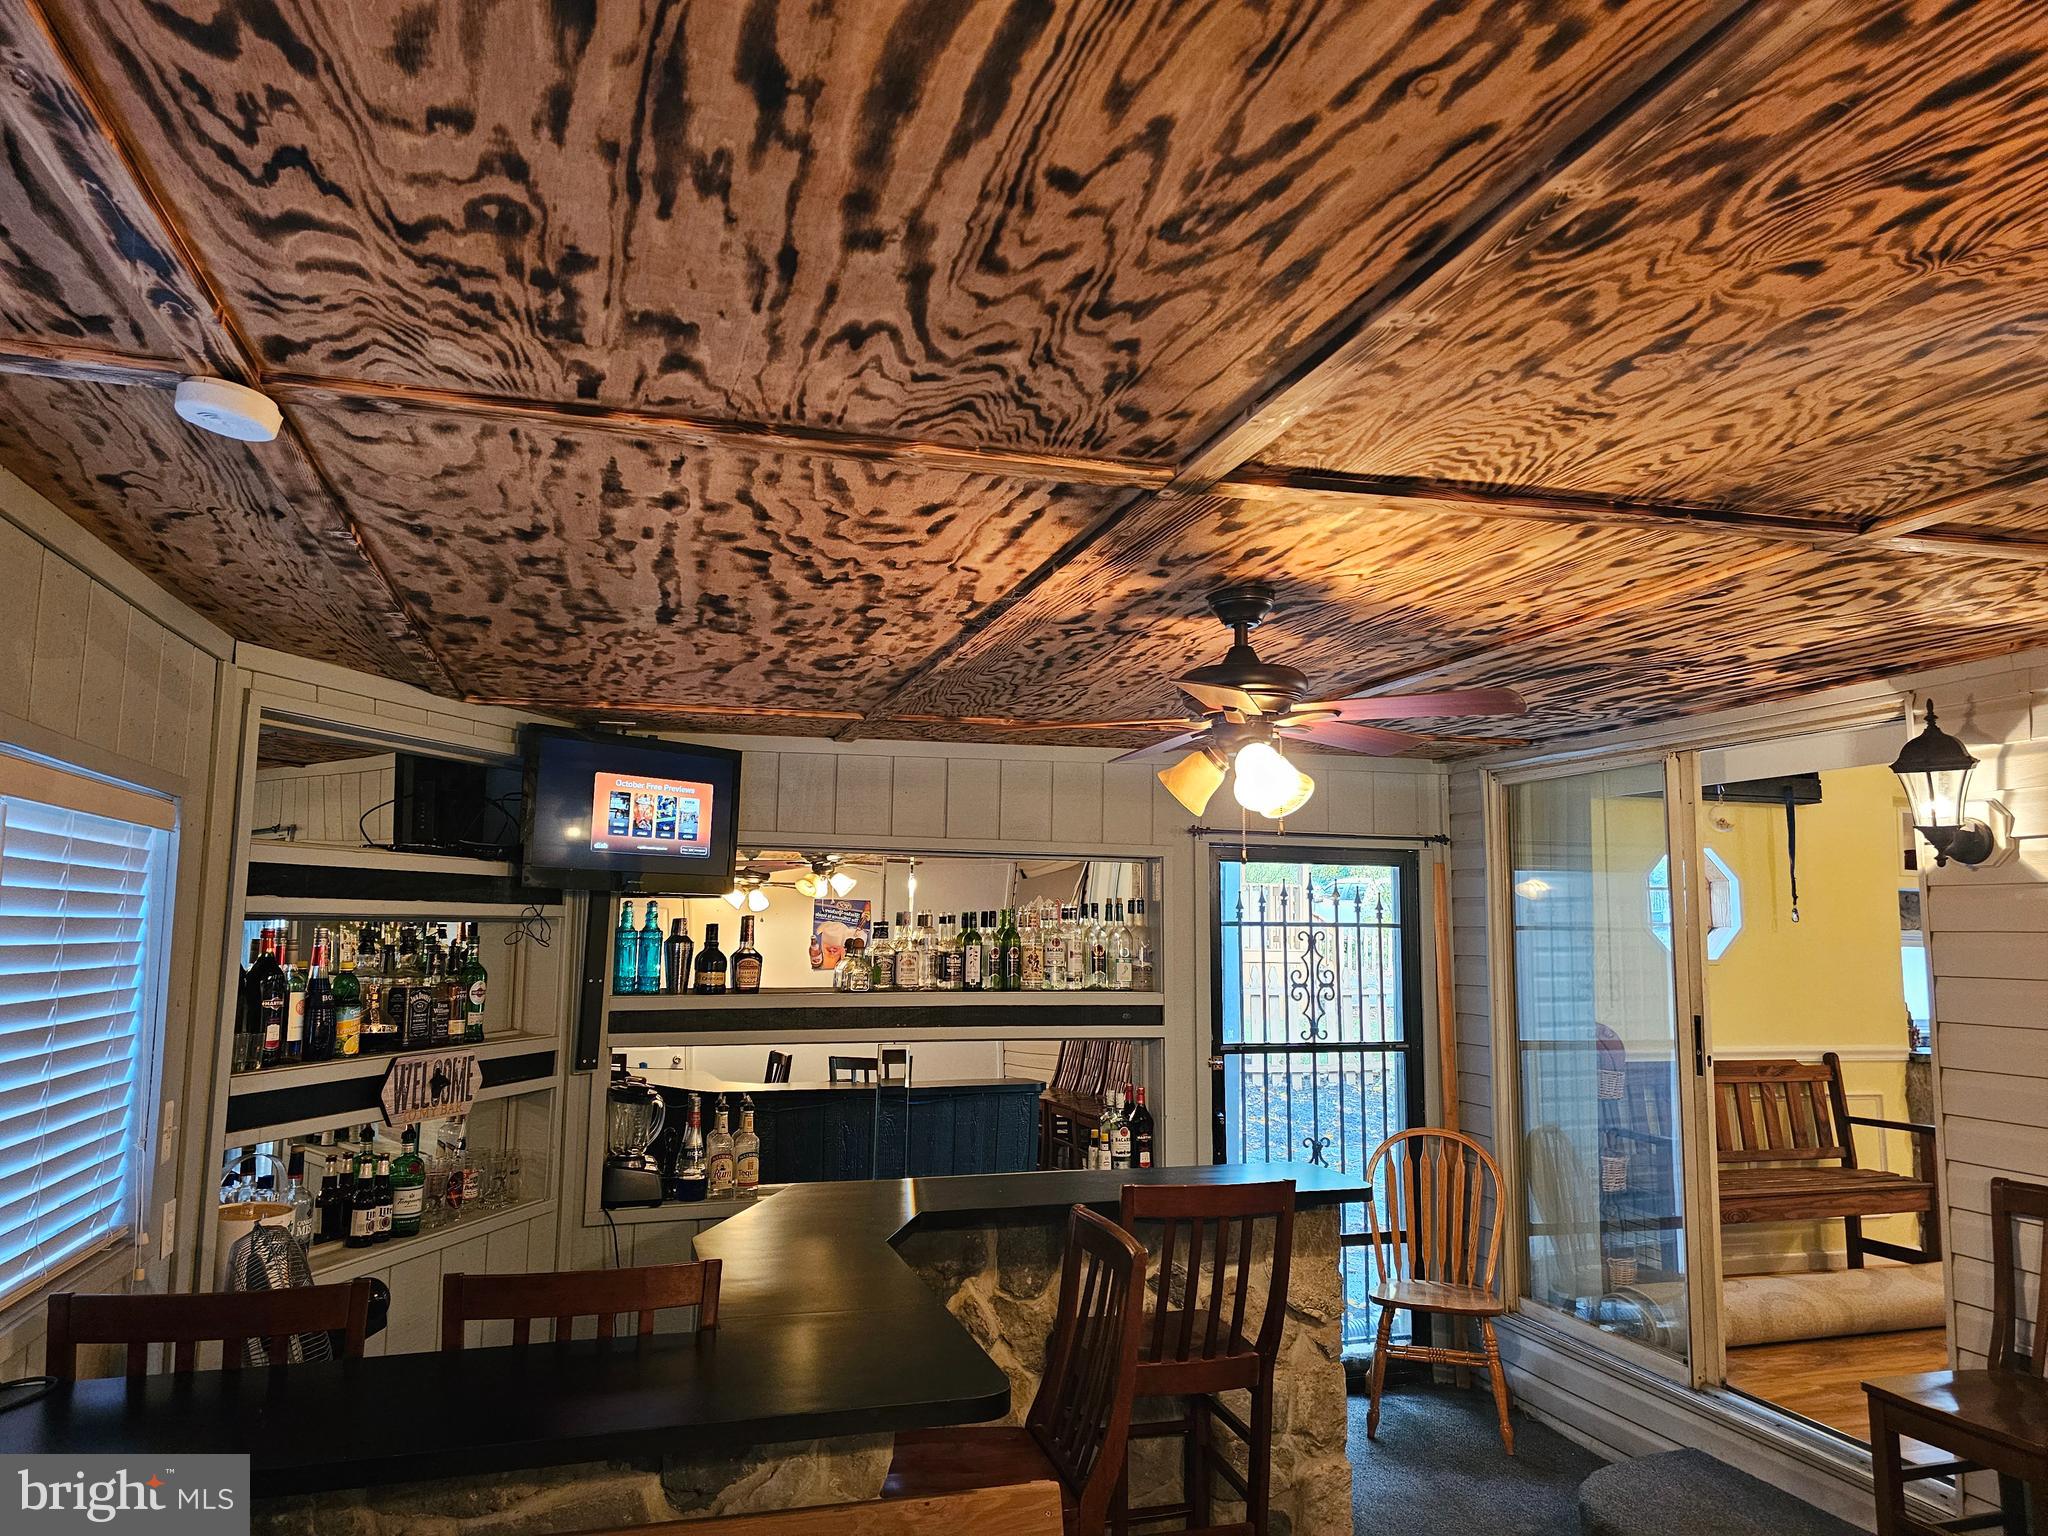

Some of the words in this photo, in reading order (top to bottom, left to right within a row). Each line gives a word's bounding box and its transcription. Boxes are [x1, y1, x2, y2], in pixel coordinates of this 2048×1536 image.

[615, 779, 644, 789] October
[664, 785, 695, 794] Previews
[394, 1055, 475, 1115] WELCOME
[440, 1103, 463, 1116] BAR
